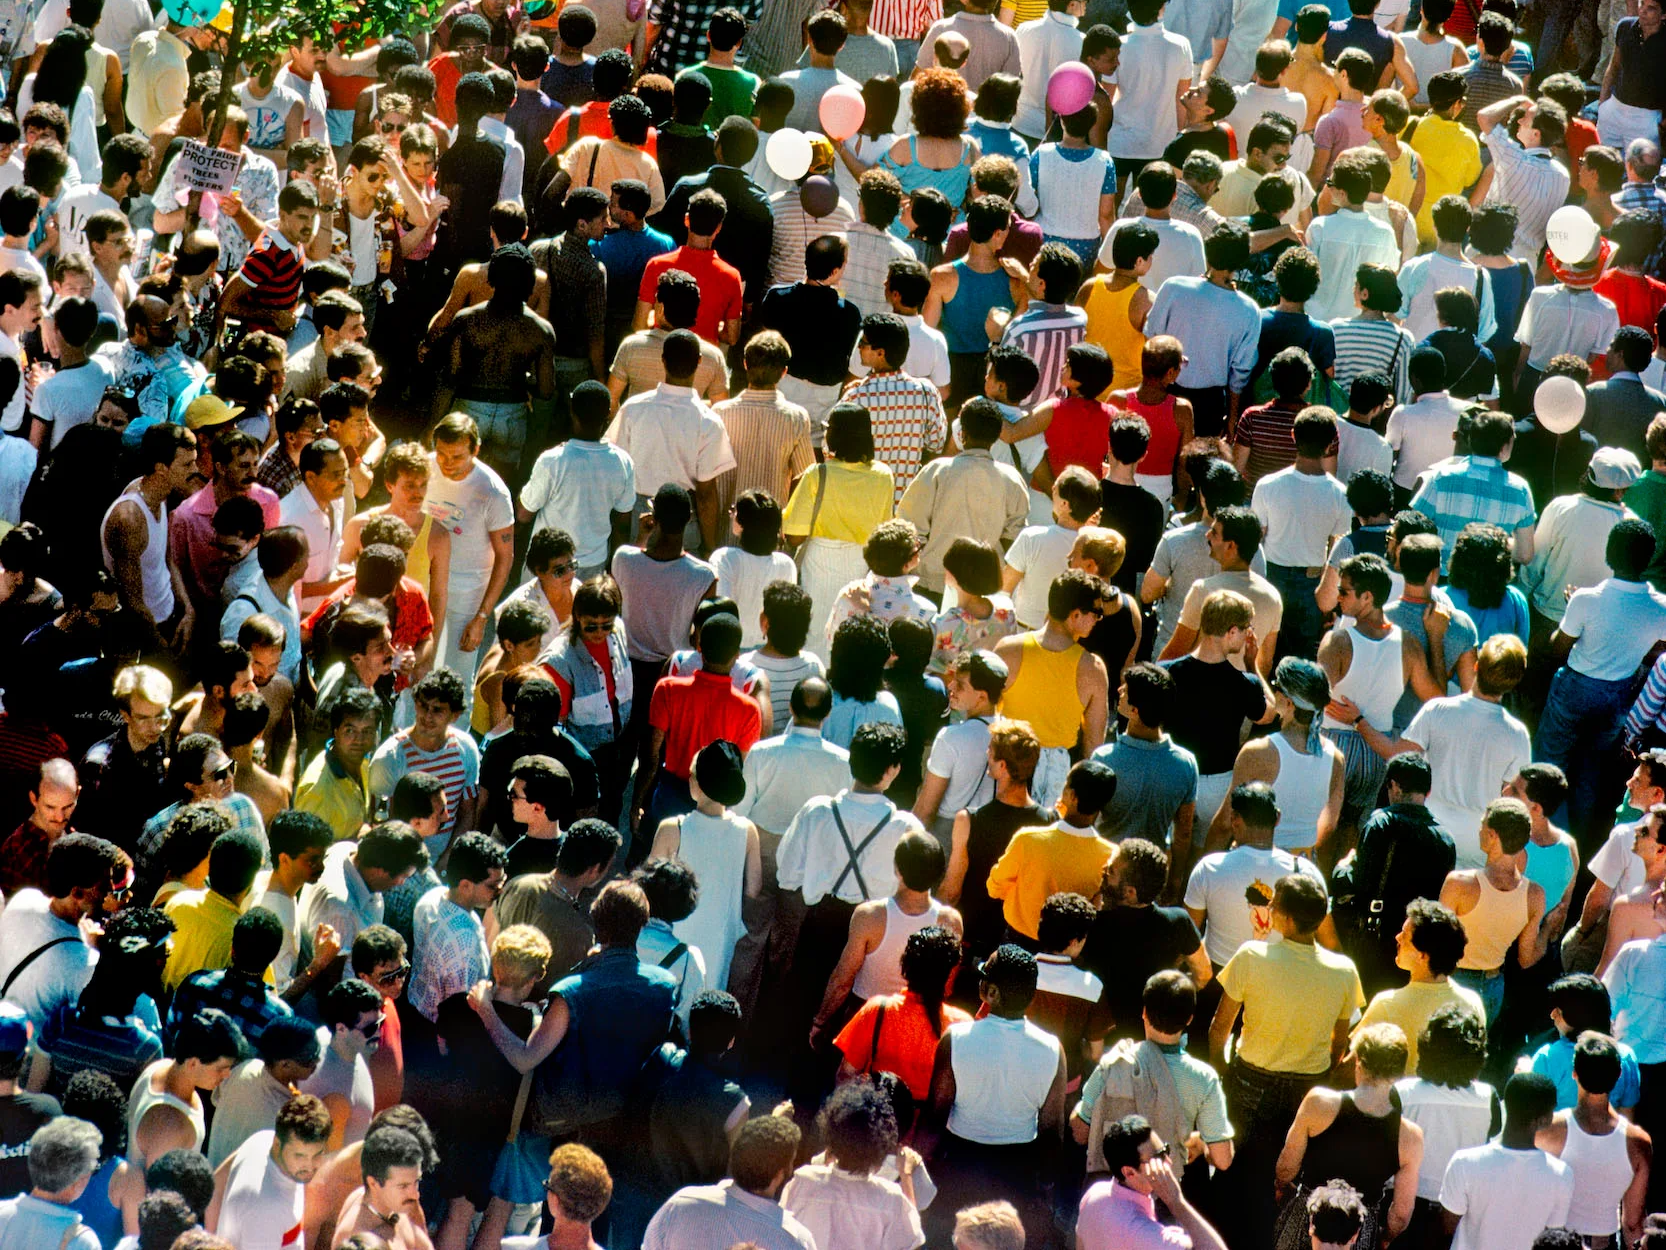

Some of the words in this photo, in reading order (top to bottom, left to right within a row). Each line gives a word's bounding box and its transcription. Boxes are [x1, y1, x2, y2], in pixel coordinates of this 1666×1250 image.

[182, 149, 238, 172] PROTECT
[185, 141, 207, 154] TAKE
[211, 150, 238, 162] PRIDE
[184, 174, 224, 191] FLOWERS
[192, 167, 219, 179] TREES
